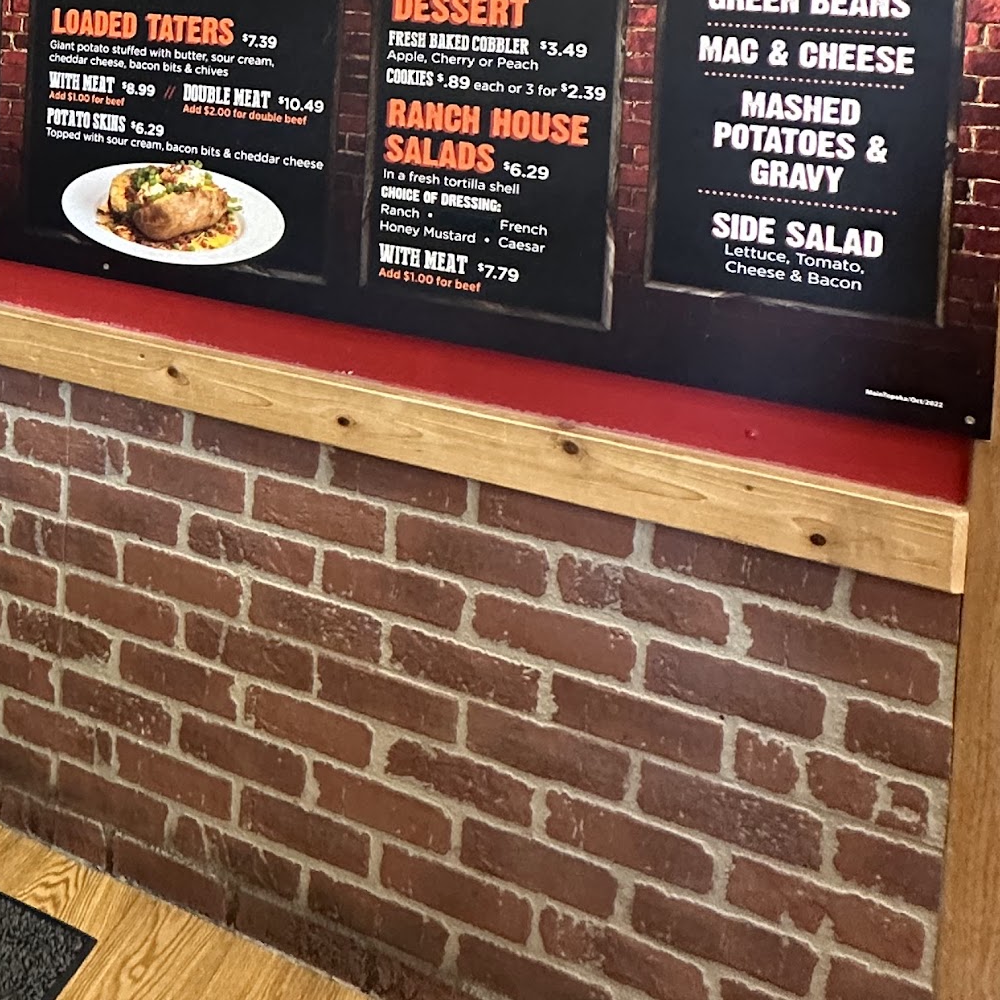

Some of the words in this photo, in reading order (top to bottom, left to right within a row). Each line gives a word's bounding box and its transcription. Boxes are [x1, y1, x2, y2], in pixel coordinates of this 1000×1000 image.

[52, 7, 137, 39] LOADED
[146, 14, 234, 46] TATERS
[242, 33, 278, 49] $7.39
[387, 50, 427, 63] Apple,
[431, 53, 474, 68] Cherry
[479, 58, 493, 67] or
[498, 58, 538, 71] Peach
[699, 35, 759, 65] MAC
[769, 39, 788, 66] &
[799, 40, 914, 75] CHEESE
[386, 98, 480, 135] RANCH
[490, 107, 589, 147] HOUSE
[741, 90, 861, 126] MASHED
[384, 134, 495, 174] SALADS
[503, 161, 549, 180] $6.29
[713, 121, 855, 161] POTATOES
[866, 135, 887, 163] &
[750, 159, 844, 194] GRAVY
[380, 221, 420, 236] Honey
[423, 227, 476, 243] Mustard
[498, 237, 545, 253] Caesar
[711, 211, 776, 245] SIDE
[786, 220, 884, 258] SALAD
[725, 244, 790, 265] Lettuce,
[796, 252, 864, 274] Tomato,
[725, 261, 785, 280] Cheese
[790, 270, 801, 282] &
[808, 272, 862, 291] Bacon
